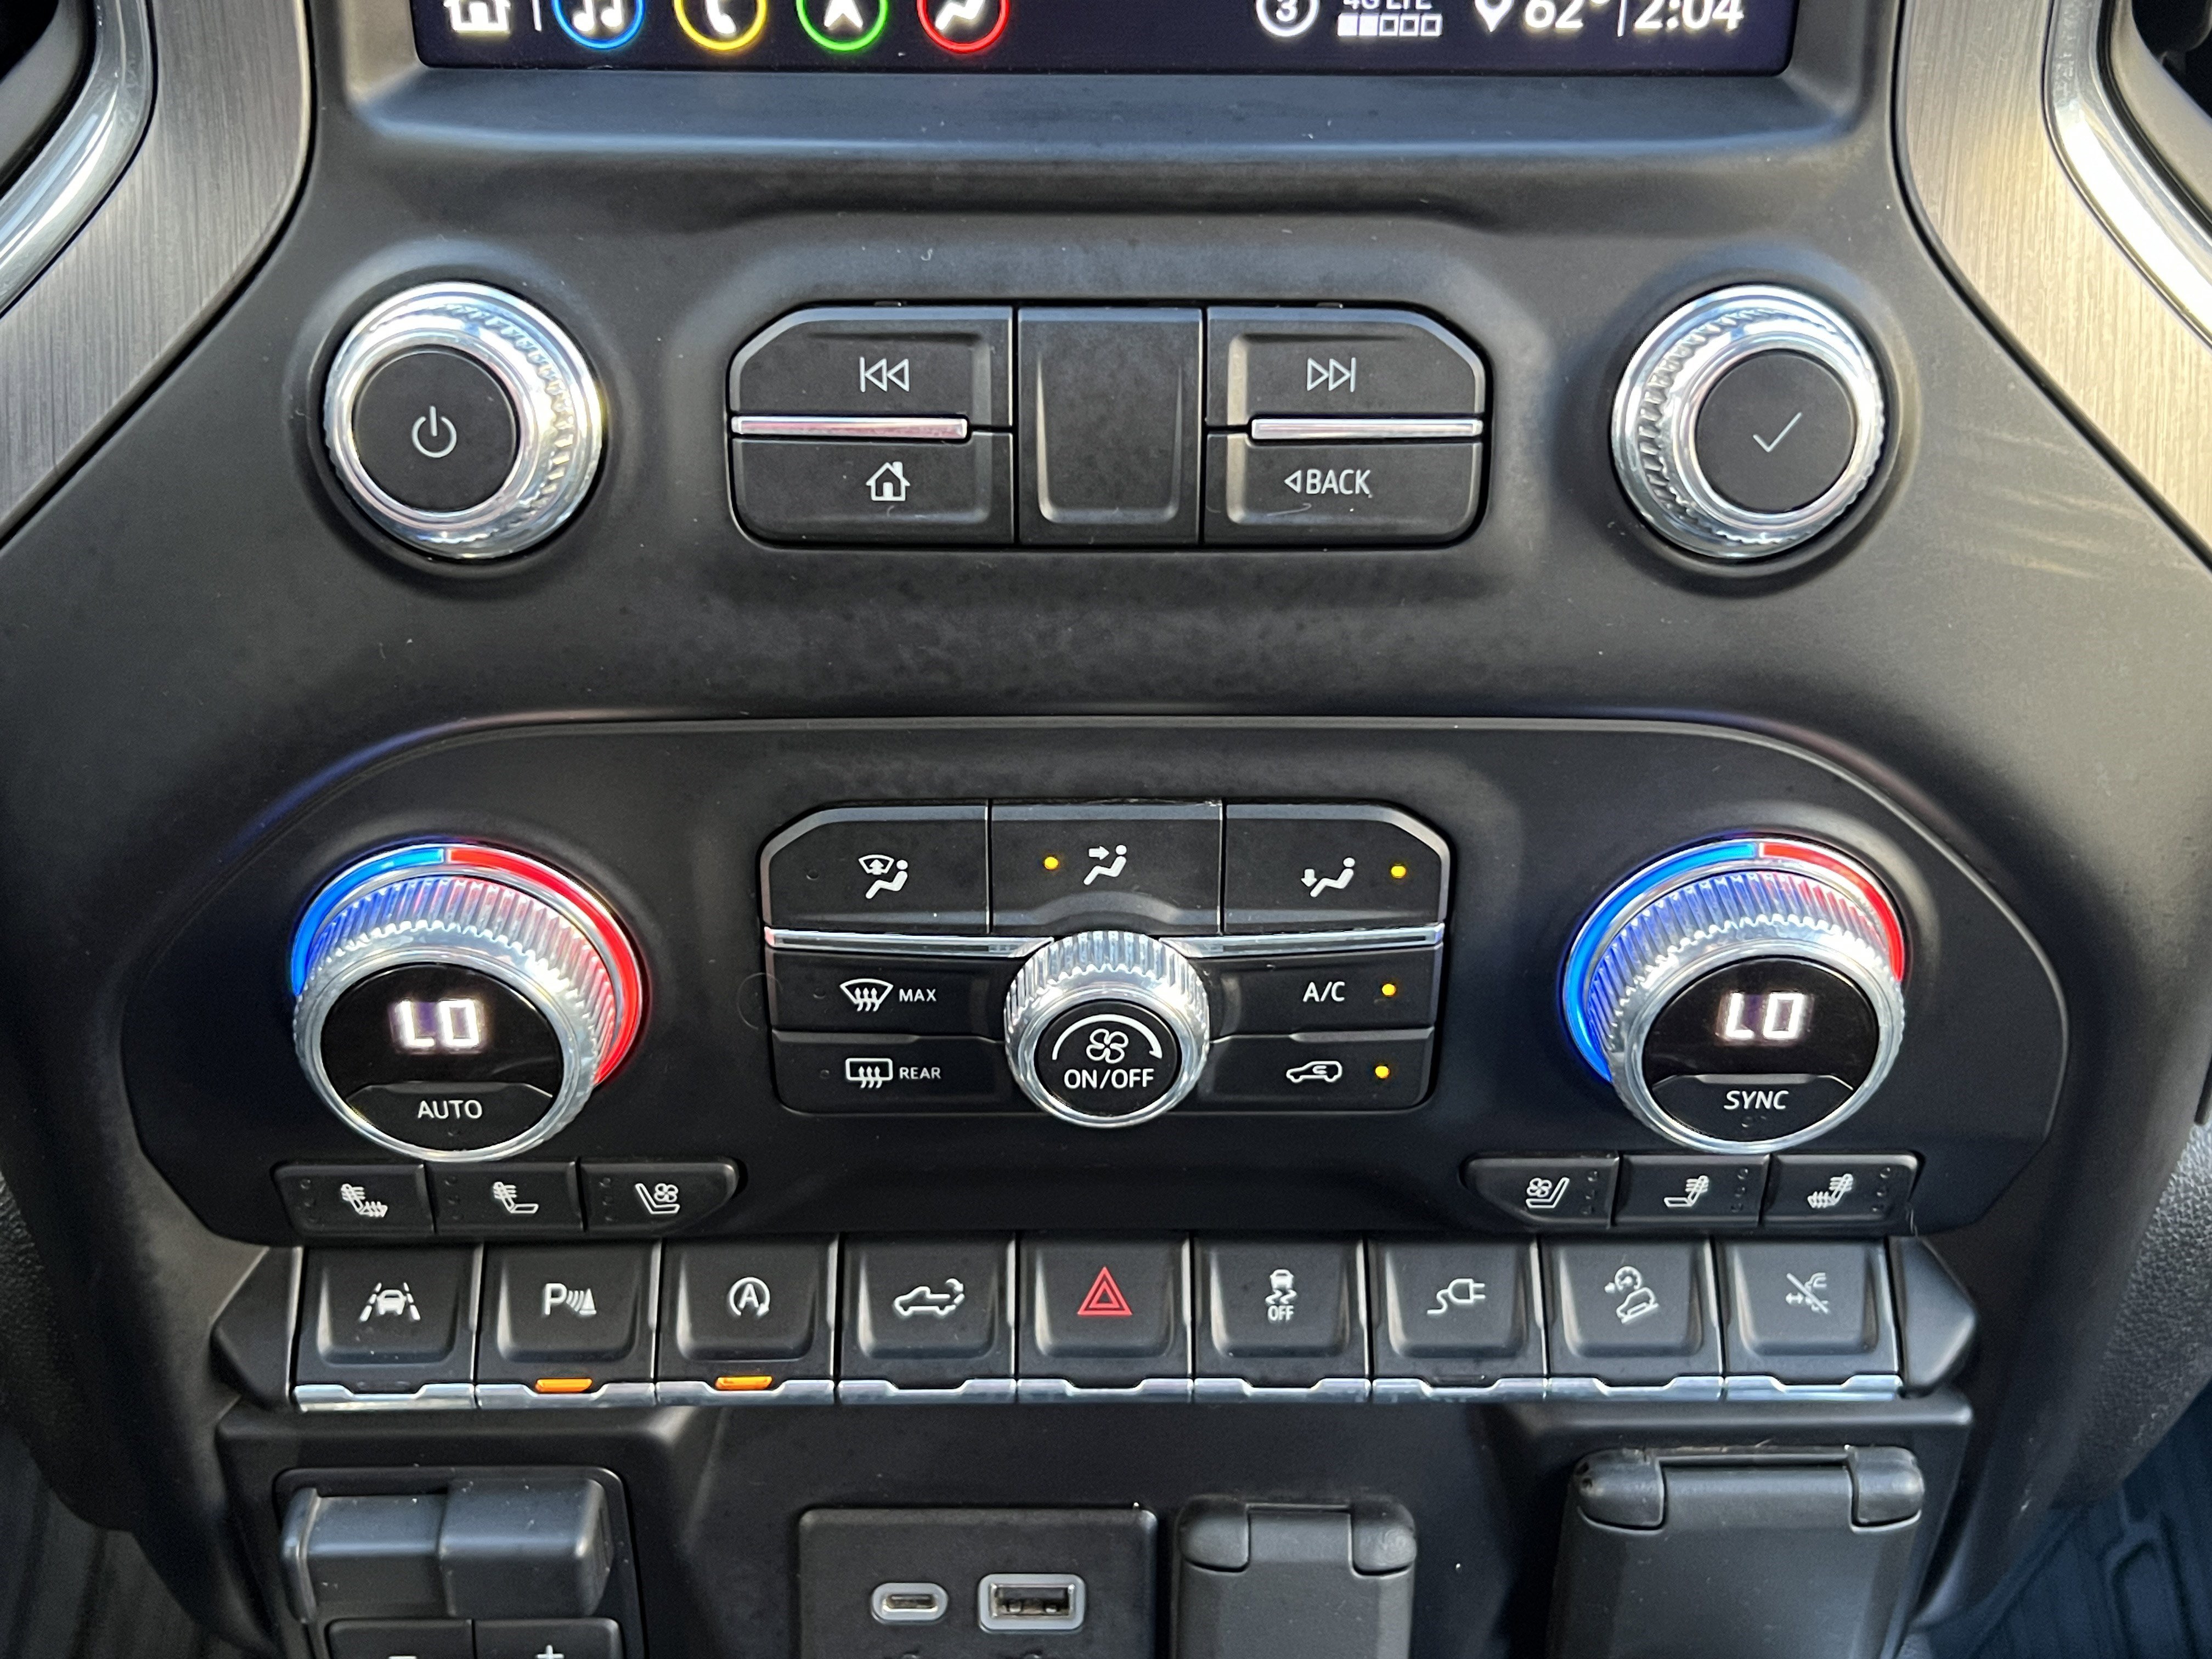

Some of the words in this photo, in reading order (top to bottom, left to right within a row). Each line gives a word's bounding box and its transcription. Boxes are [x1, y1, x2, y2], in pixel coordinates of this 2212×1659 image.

[1306, 468, 1372, 495] BACK
[899, 989, 936, 1002] MAX
[1302, 981, 1345, 1002] A/C
[394, 998, 481, 1048] LO
[1725, 991, 1807, 1041] LO
[899, 1066, 941, 1080] REAR
[1064, 1068, 1154, 1090] ON/OFF
[417, 1099, 483, 1120] AUTO
[1723, 1090, 1790, 1110] SYNC
[1267, 1305, 1294, 1323] OFF
